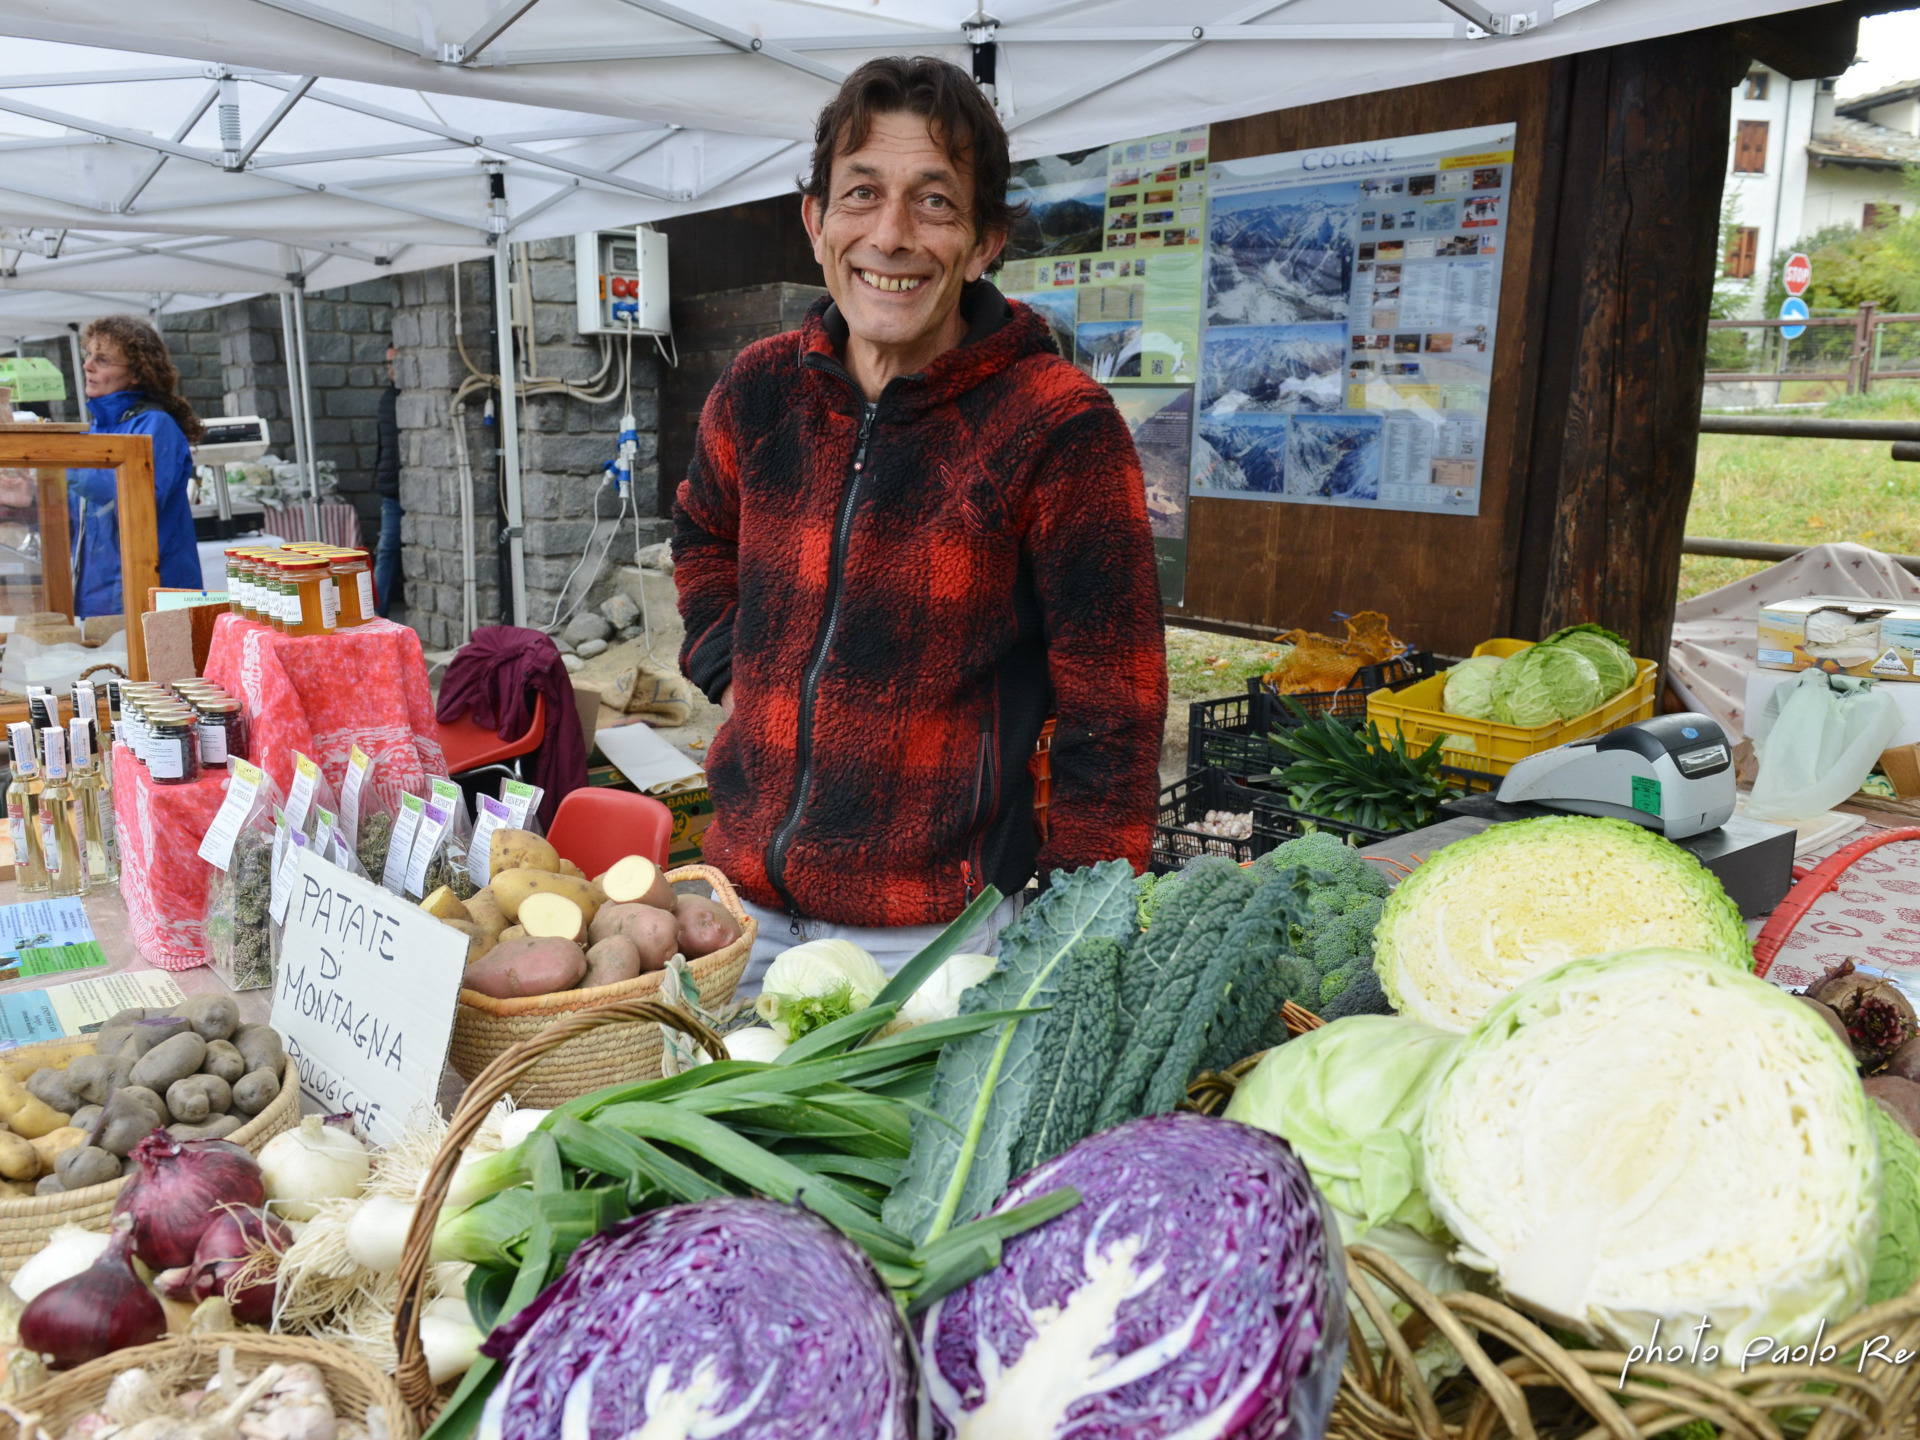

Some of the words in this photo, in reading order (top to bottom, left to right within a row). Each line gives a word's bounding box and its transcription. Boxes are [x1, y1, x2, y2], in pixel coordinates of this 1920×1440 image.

[1301, 145, 1394, 171] COGNE
[1785, 266, 1810, 283] STOP
[433, 797, 453, 810] GENEPY
[504, 794, 528, 808] GENEPY
[666, 791, 710, 808] BANAN
[300, 873, 400, 961] PATATE
[283, 963, 403, 1072] MONTAGNA
[288, 1034, 381, 1132] BIOLOGICHE
